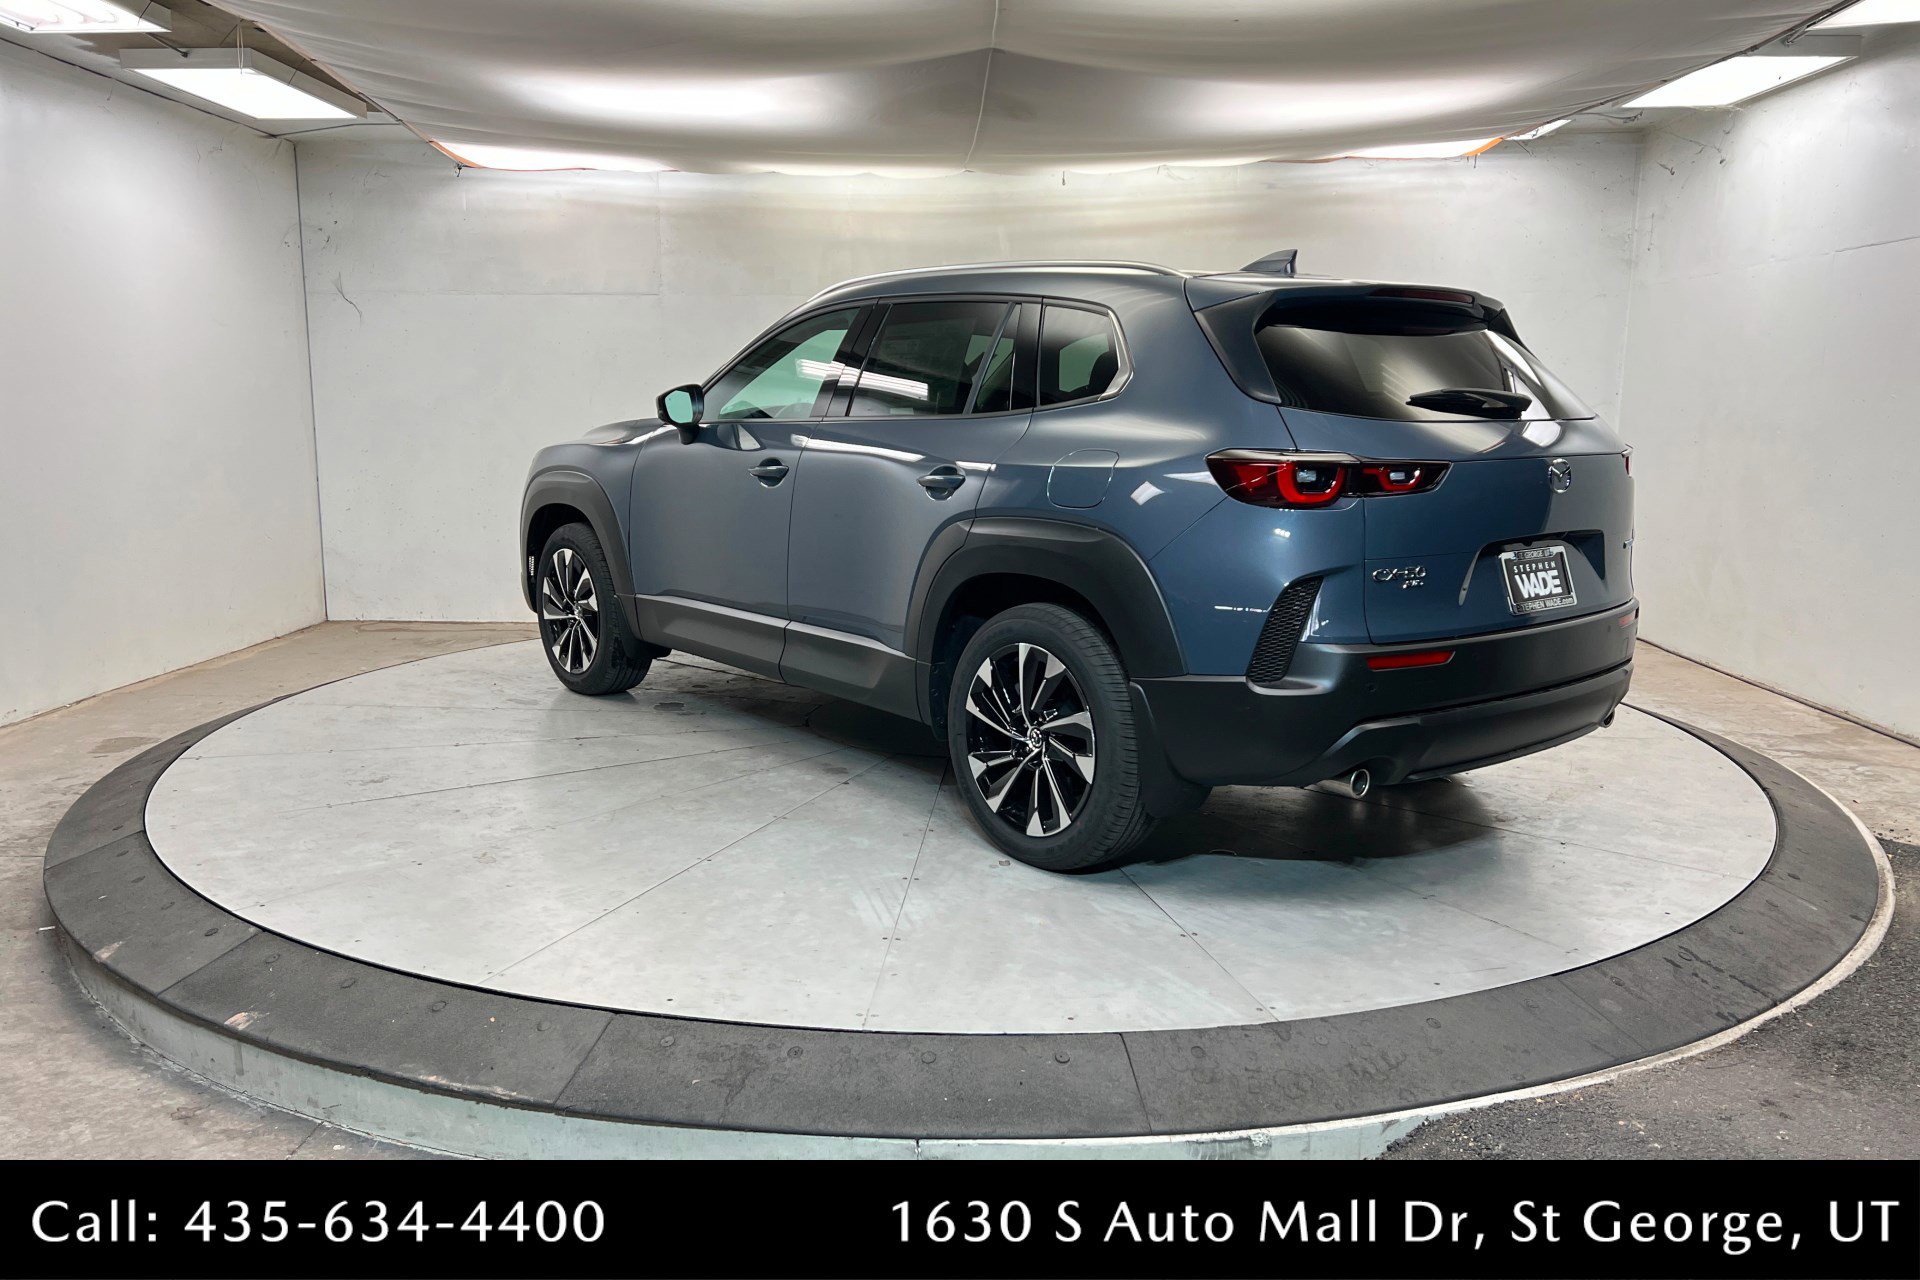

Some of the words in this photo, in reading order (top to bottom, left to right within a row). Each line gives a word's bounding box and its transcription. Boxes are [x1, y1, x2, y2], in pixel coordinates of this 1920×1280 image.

[1372, 566, 1426, 581] CX-50
[1513, 561, 1556, 573] STEPHEN
[1514, 569, 1563, 599] WADE
